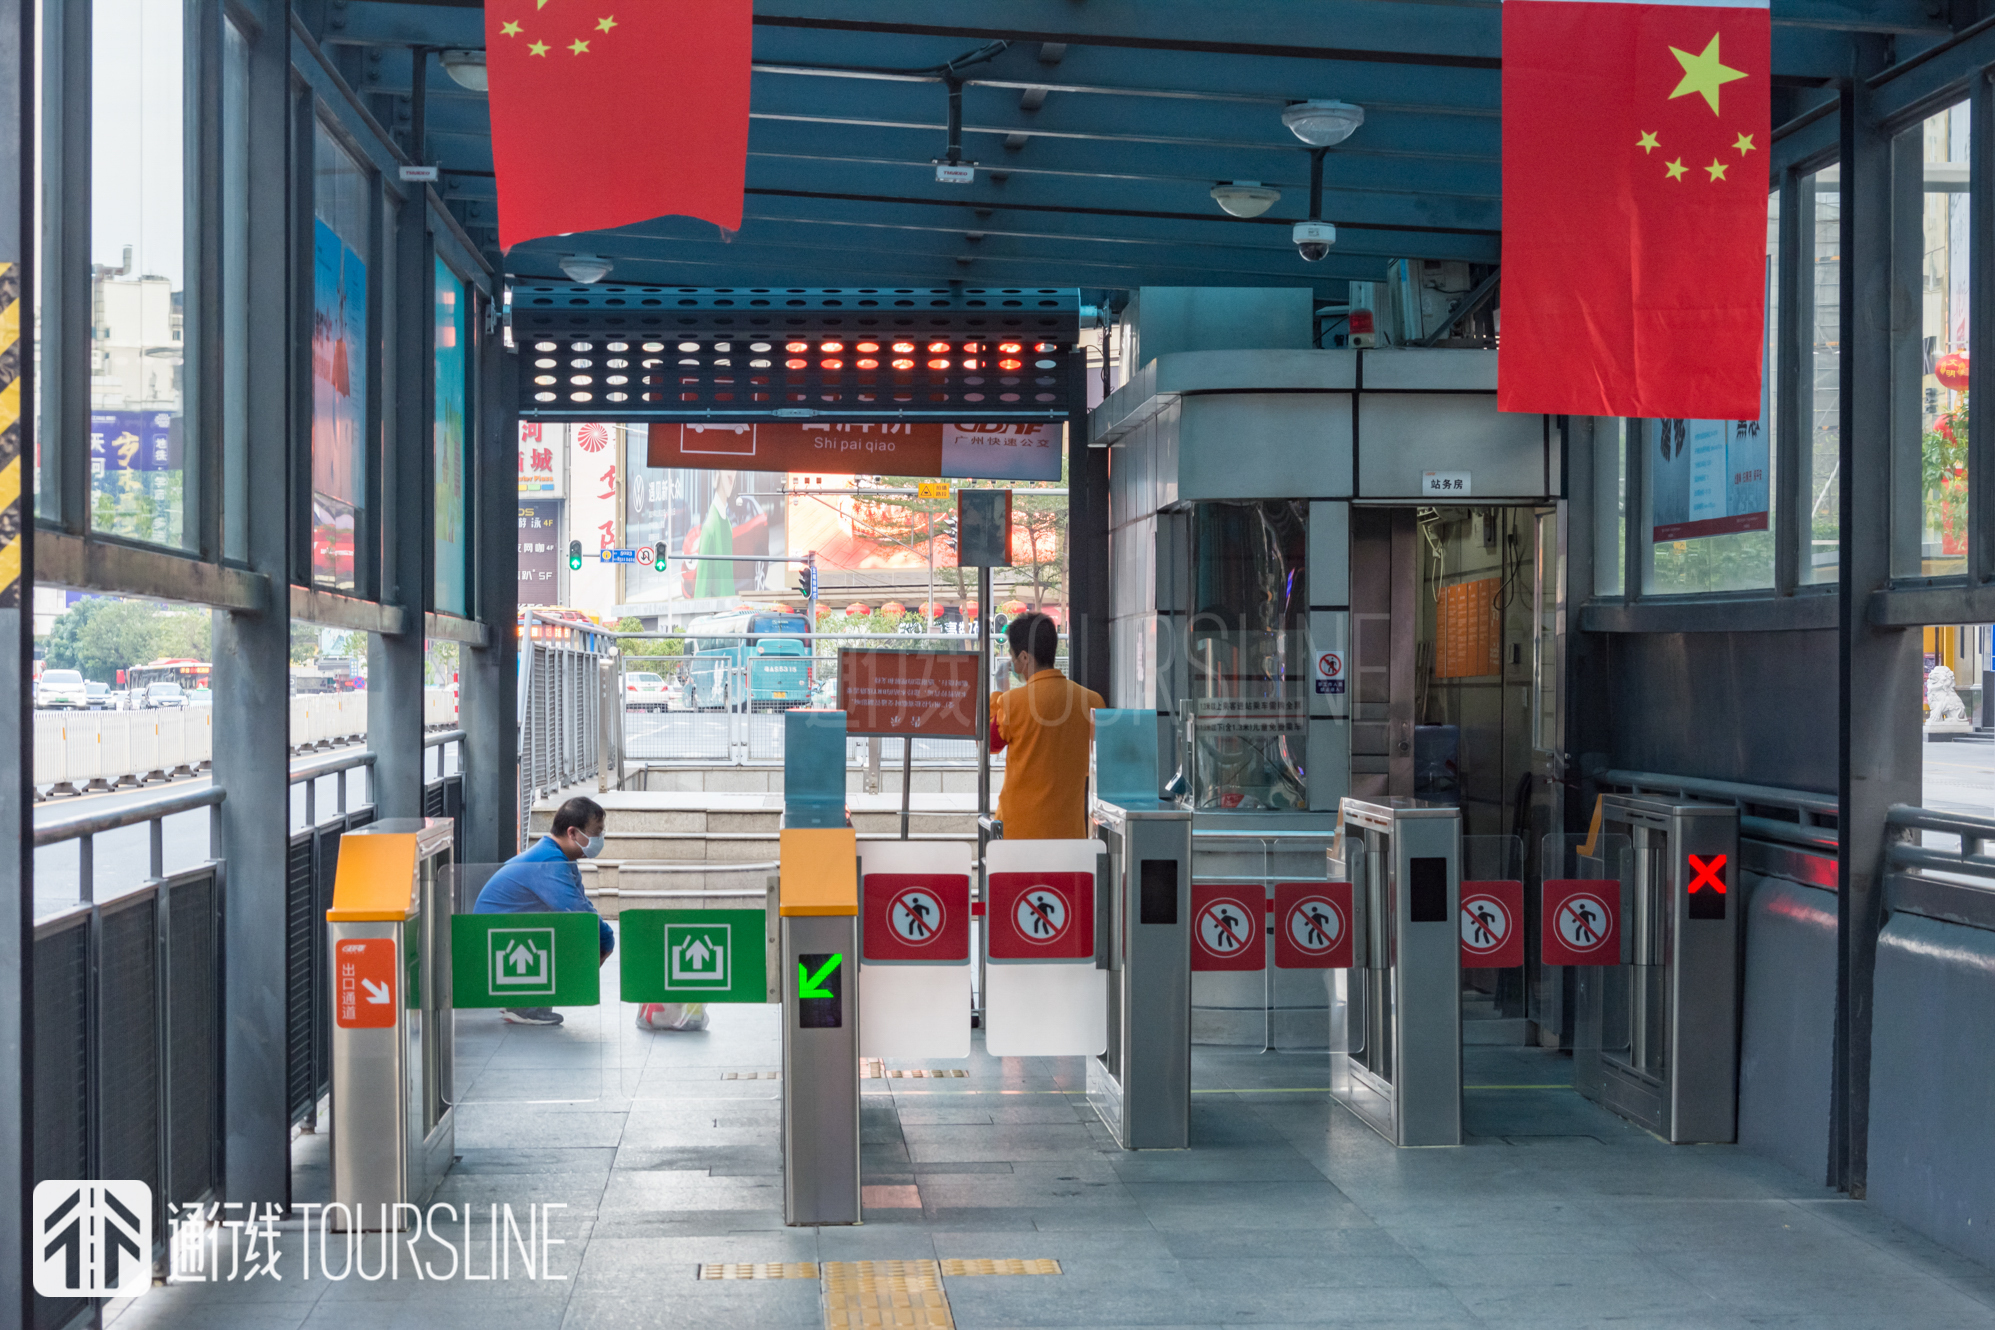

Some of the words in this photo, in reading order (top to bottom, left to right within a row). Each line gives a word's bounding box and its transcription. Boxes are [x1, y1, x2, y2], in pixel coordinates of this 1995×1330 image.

[1946, 359, 1958, 377] 文明
[814, 437, 837, 449] Shi
[841, 438, 862, 451] pai
[866, 439, 896, 453] qiao
[955, 436, 1049, 448] 广州快速公交
[518, 448, 553, 472] 城
[1431, 479, 1463, 489] 站务房
[539, 572, 553, 580] 5F
[890, 715, 921, 728] 告示
[342, 963, 356, 1020] 出口通道
